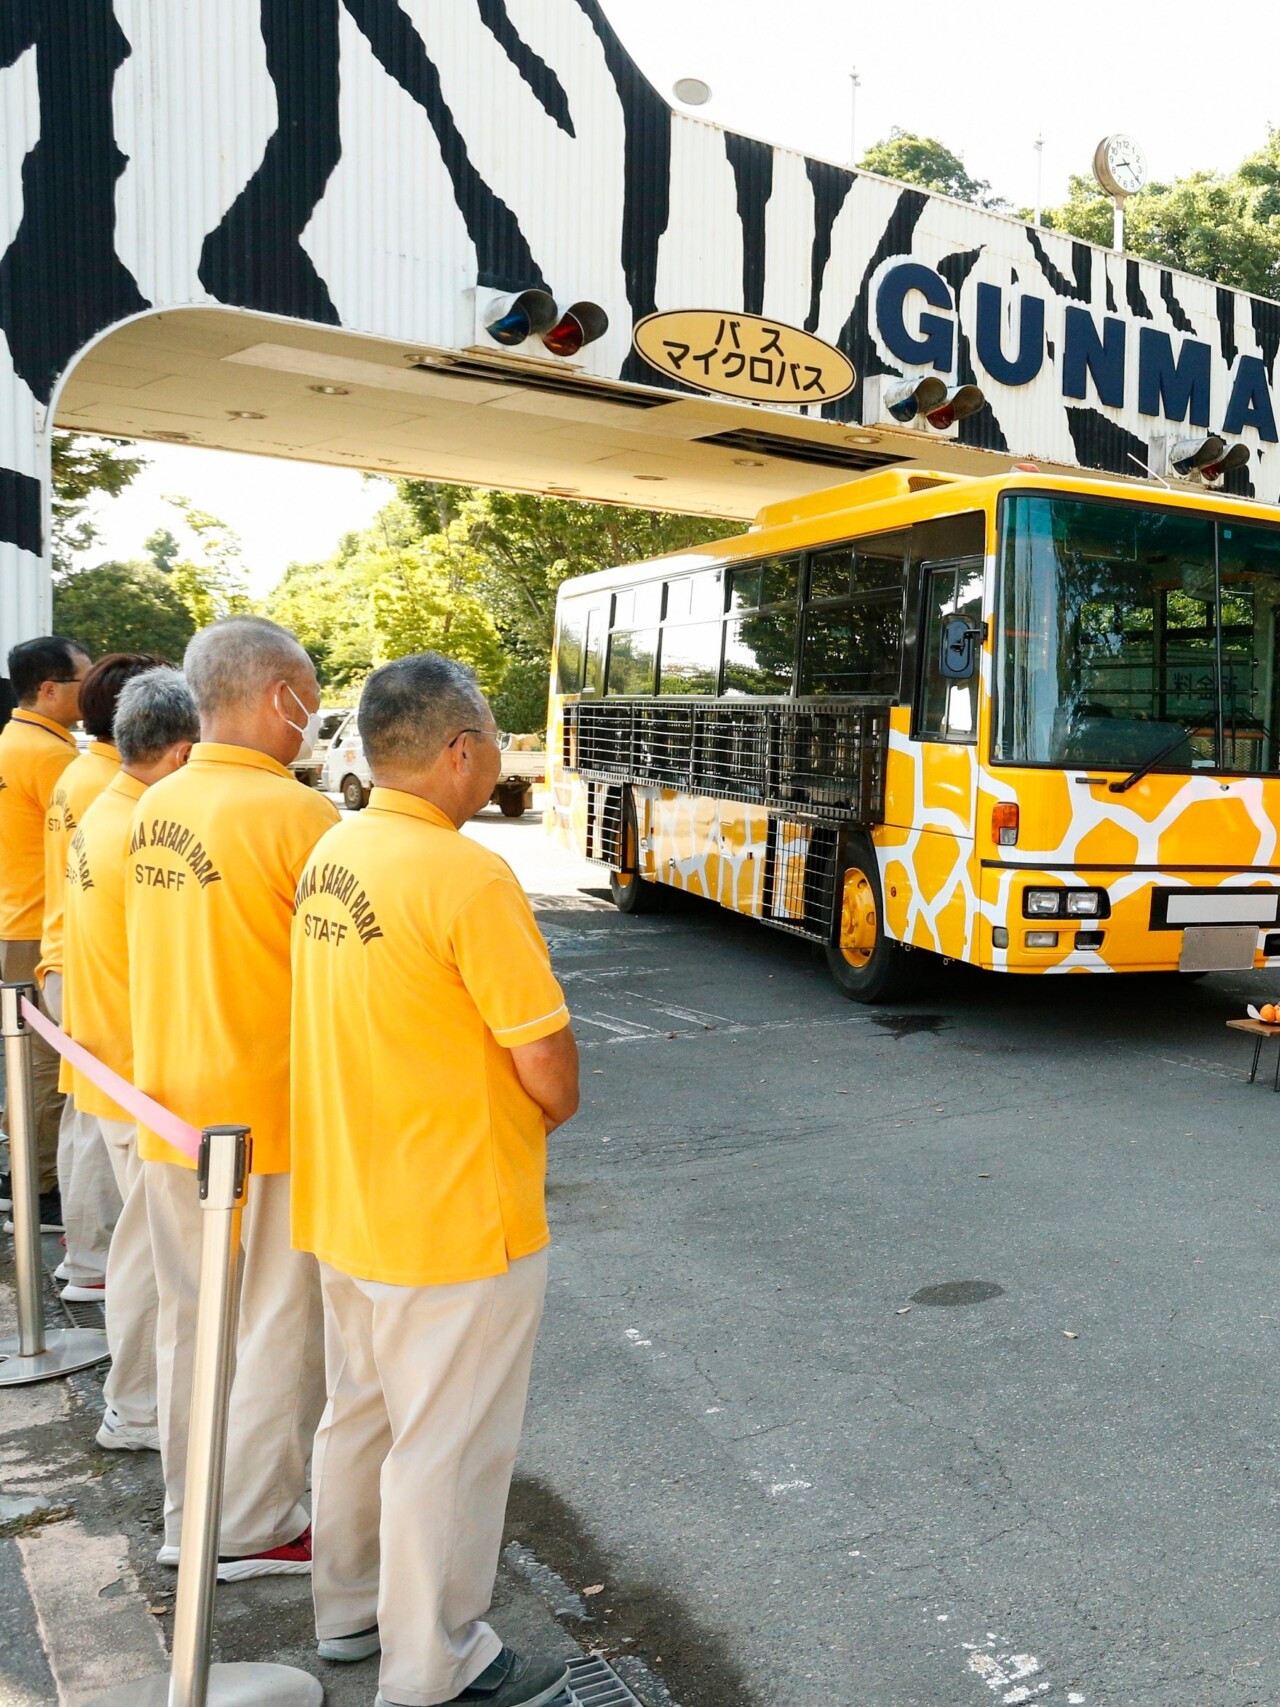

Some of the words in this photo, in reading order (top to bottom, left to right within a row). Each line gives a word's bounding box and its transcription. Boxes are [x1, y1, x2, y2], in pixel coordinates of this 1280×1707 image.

[715, 319, 784, 357] バス
[876, 263, 1278, 443] GUNMA
[662, 340, 826, 394] マイクロバス
[135, 863, 186, 892] STAFF
[150, 819, 195, 856] SAFARI
[185, 841, 222, 889] PARK
[305, 913, 348, 947] STAFF
[320, 863, 359, 906] SAFARI
[349, 890, 384, 945] PARK
